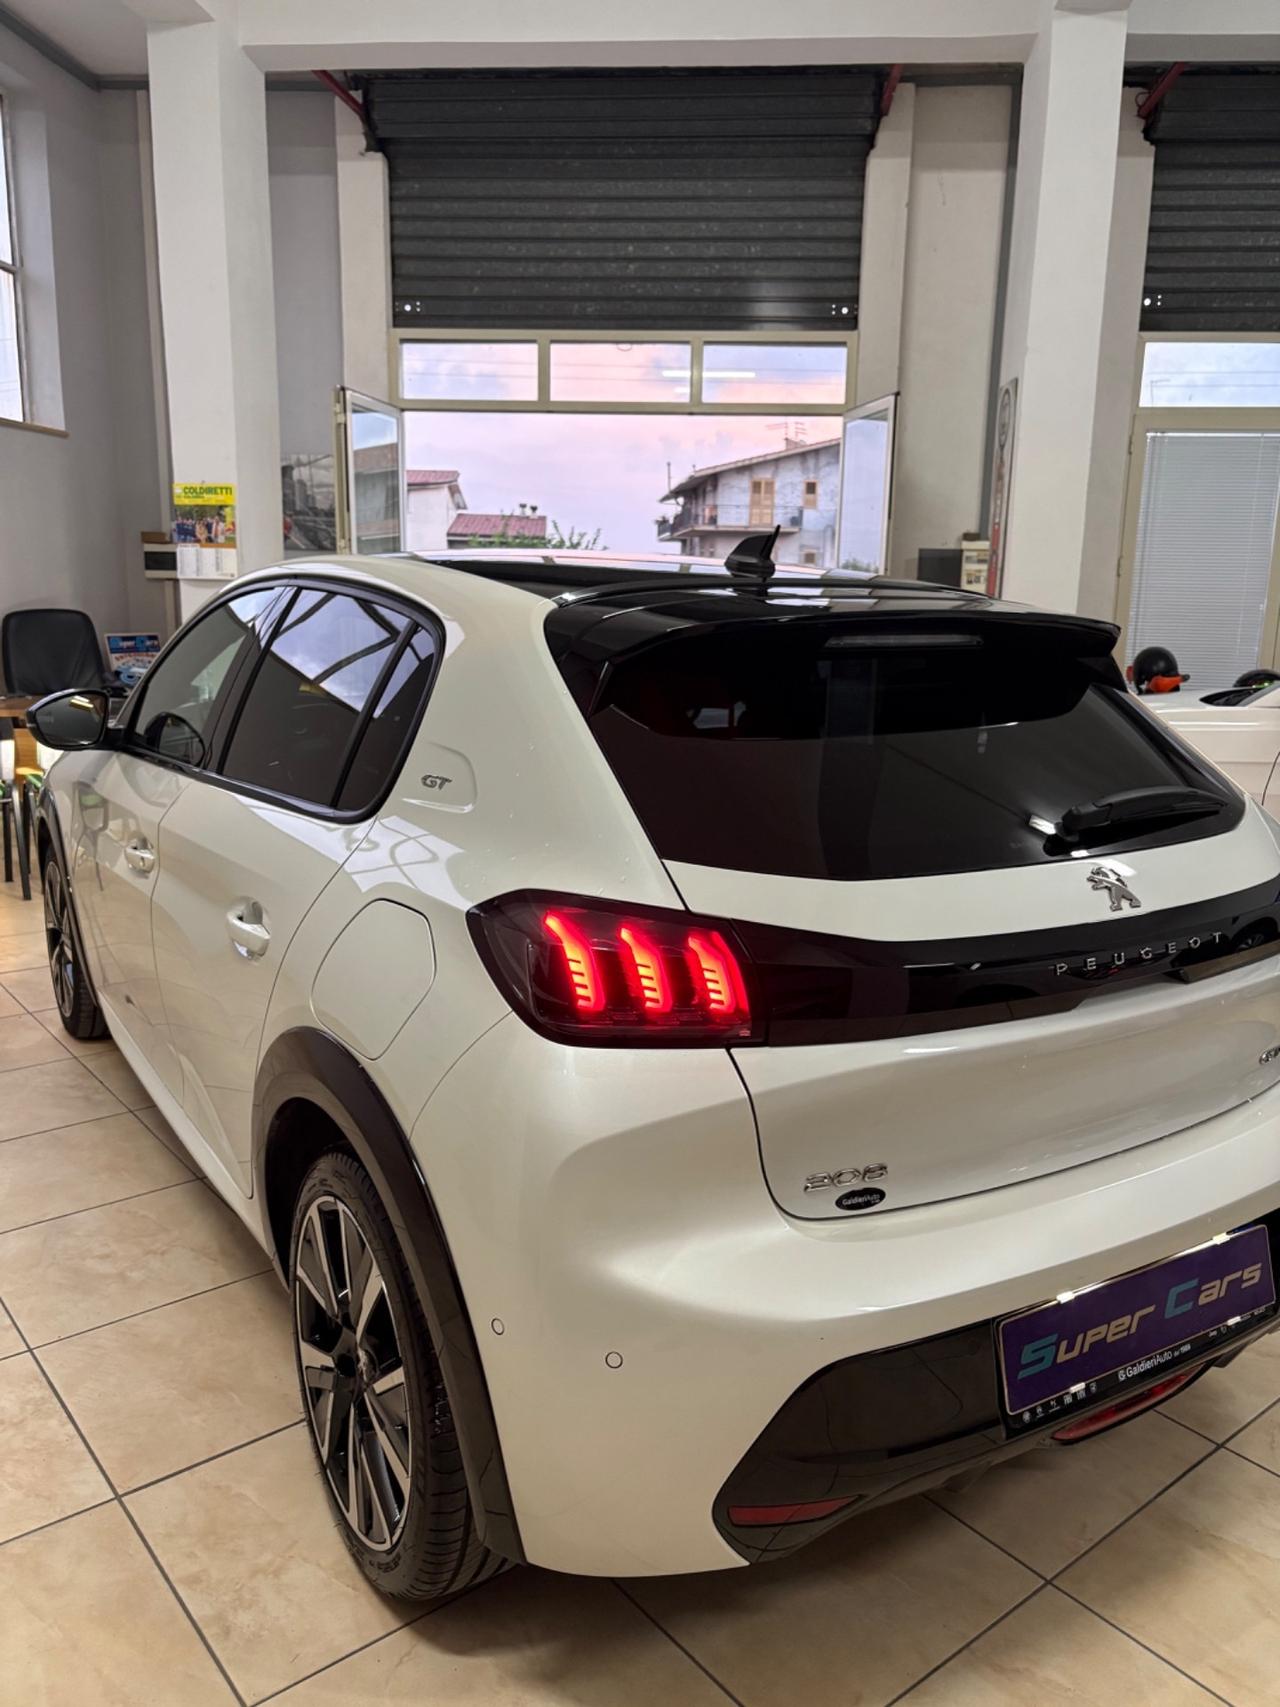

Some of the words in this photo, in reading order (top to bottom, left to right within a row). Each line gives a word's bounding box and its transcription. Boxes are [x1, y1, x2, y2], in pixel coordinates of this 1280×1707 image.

[183, 486, 232, 496] COLDIRETTI
[421, 774, 453, 790] GT
[1056, 931, 1222, 975] PEUGEOT
[804, 1163, 888, 1192] 208
